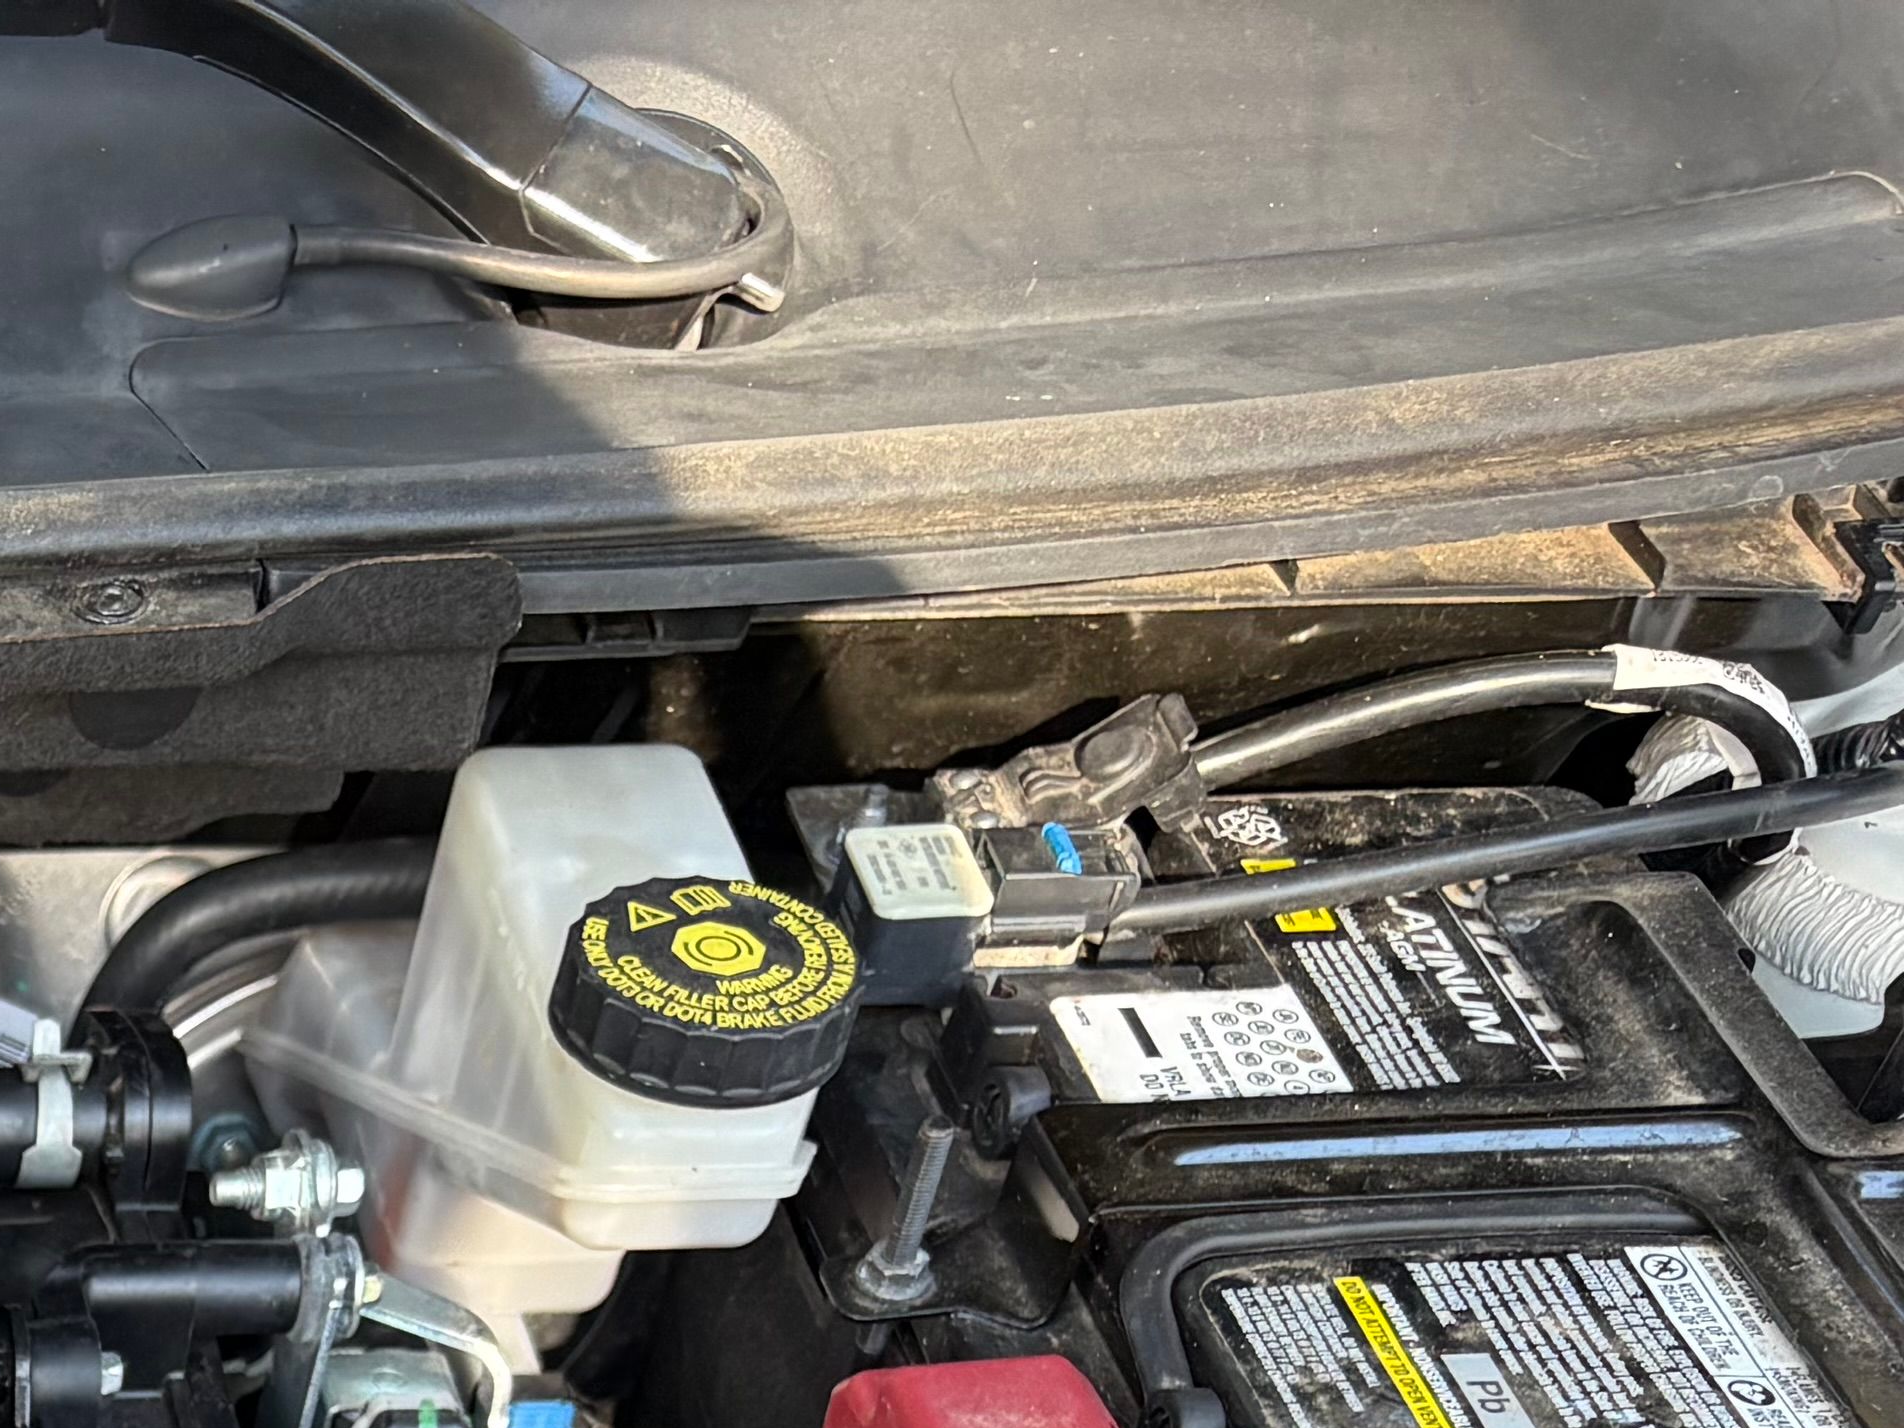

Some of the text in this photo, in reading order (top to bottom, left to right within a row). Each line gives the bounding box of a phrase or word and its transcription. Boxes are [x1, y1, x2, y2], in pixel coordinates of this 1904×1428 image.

[728, 881, 824, 924] CONTAINER
[581, 917, 609, 941] USE
[582, 940, 613, 967] ONLY
[814, 922, 855, 965] SEALED
[617, 911, 827, 1011] CLEAN FILLER CAP BEFORE REMOVING
[1385, 895, 1517, 1045] ATINUM
[598, 967, 641, 998] DOT3
[716, 964, 792, 995] WARNING
[635, 991, 665, 1012] OR
[663, 1001, 713, 1025] DOT4
[780, 996, 829, 1023] FLUID
[716, 1009, 784, 1029] BRAKE
[1339, 1281, 1361, 1293] DO
[1657, 1284, 1690, 1312] REACH
[1675, 1282, 1704, 1304] KEEP
[1347, 1296, 1375, 1315] NOT
[1371, 1284, 1419, 1341] IMPORTANT
[1357, 1317, 1404, 1361] ATTEMPT
[1396, 1377, 1430, 1403] OPEN
[1466, 1380, 1505, 1414] Pb
